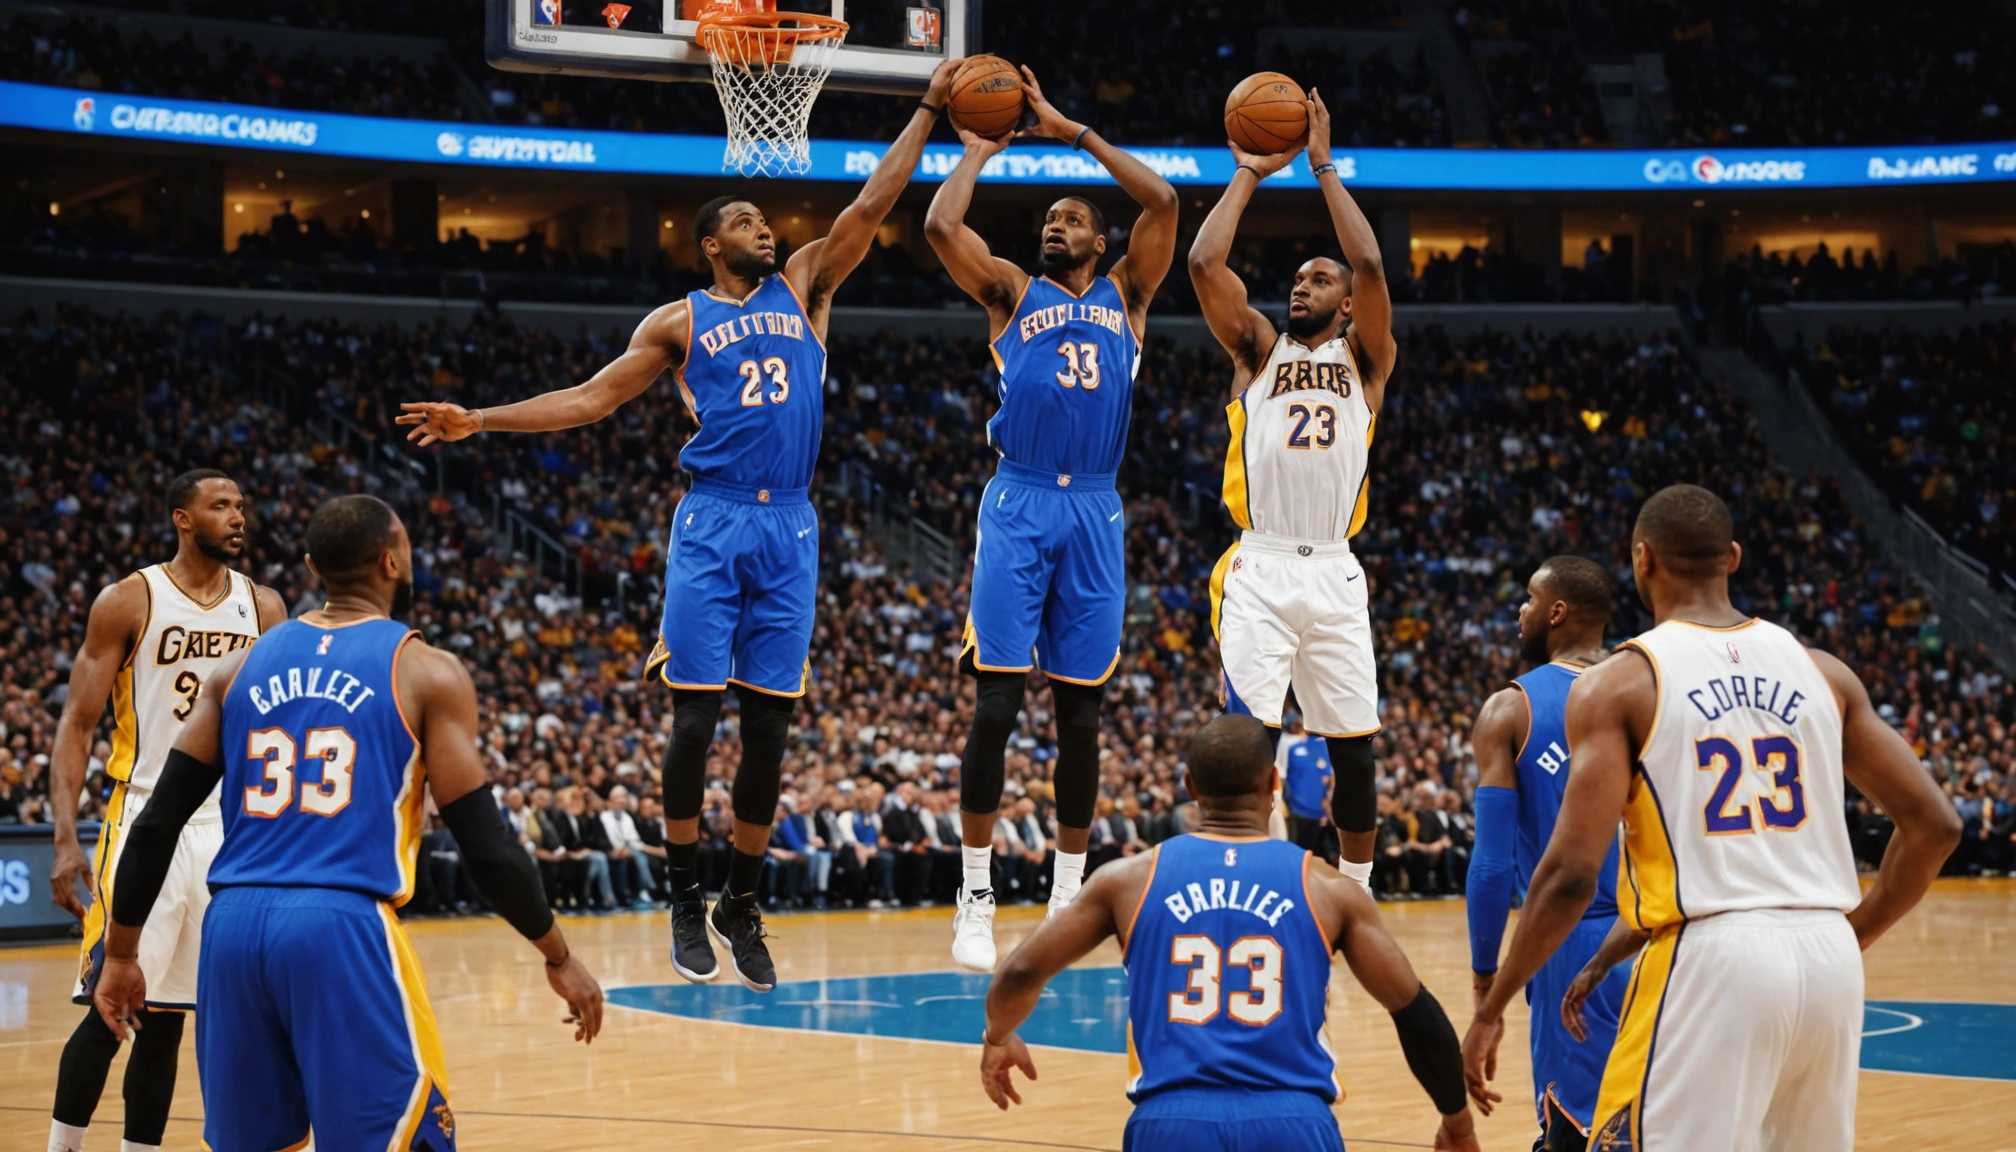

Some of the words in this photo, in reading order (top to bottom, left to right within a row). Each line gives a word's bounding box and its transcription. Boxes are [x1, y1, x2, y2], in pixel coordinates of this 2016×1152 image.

[738, 356, 790, 407] 23
[1286, 402, 1337, 451] 23
[243, 726, 357, 818] 33
[1694, 734, 1809, 837] 23
[0, 858, 30, 907] S
[1168, 934, 1284, 1027] 33
